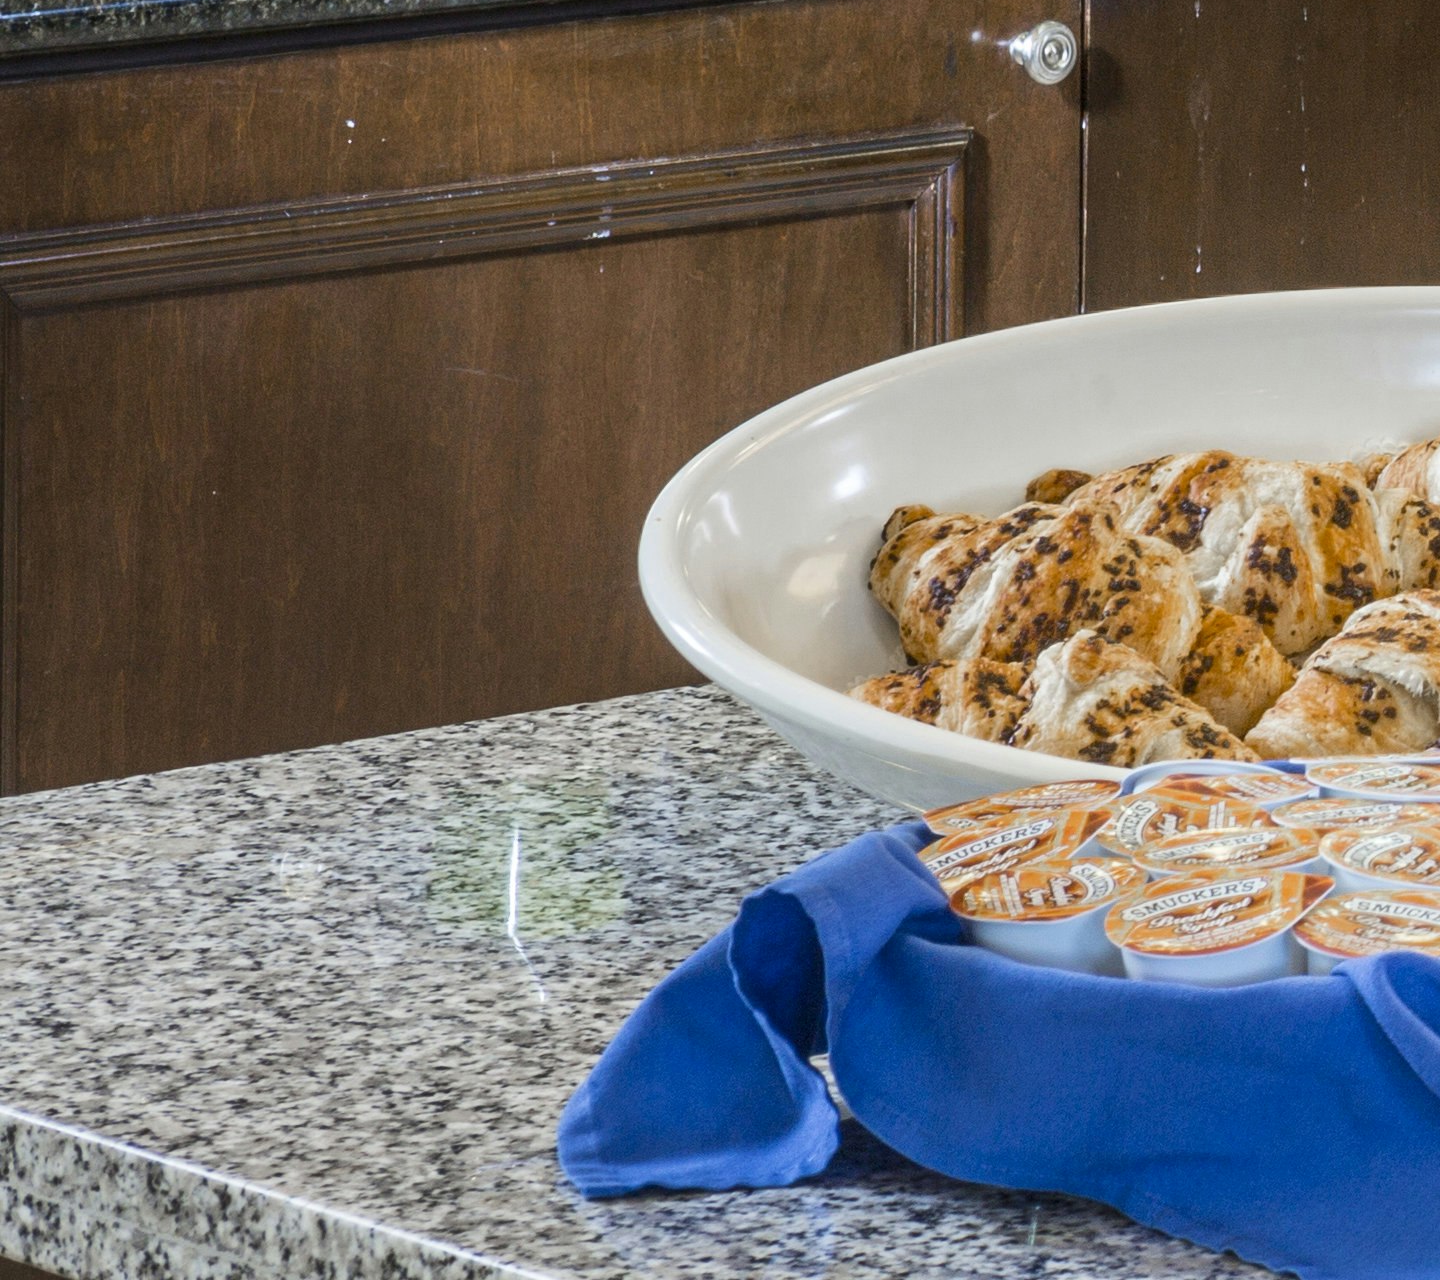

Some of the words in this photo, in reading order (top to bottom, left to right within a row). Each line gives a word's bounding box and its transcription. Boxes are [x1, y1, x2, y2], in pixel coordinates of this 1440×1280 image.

[926, 822, 1044, 873] SMUCKER'S
[938, 838, 1038, 881] Breakfast
[1130, 879, 1256, 919] SMUCKER'S
[1148, 896, 1254, 929] Breakfast
[1174, 914, 1236, 935] Syrup
